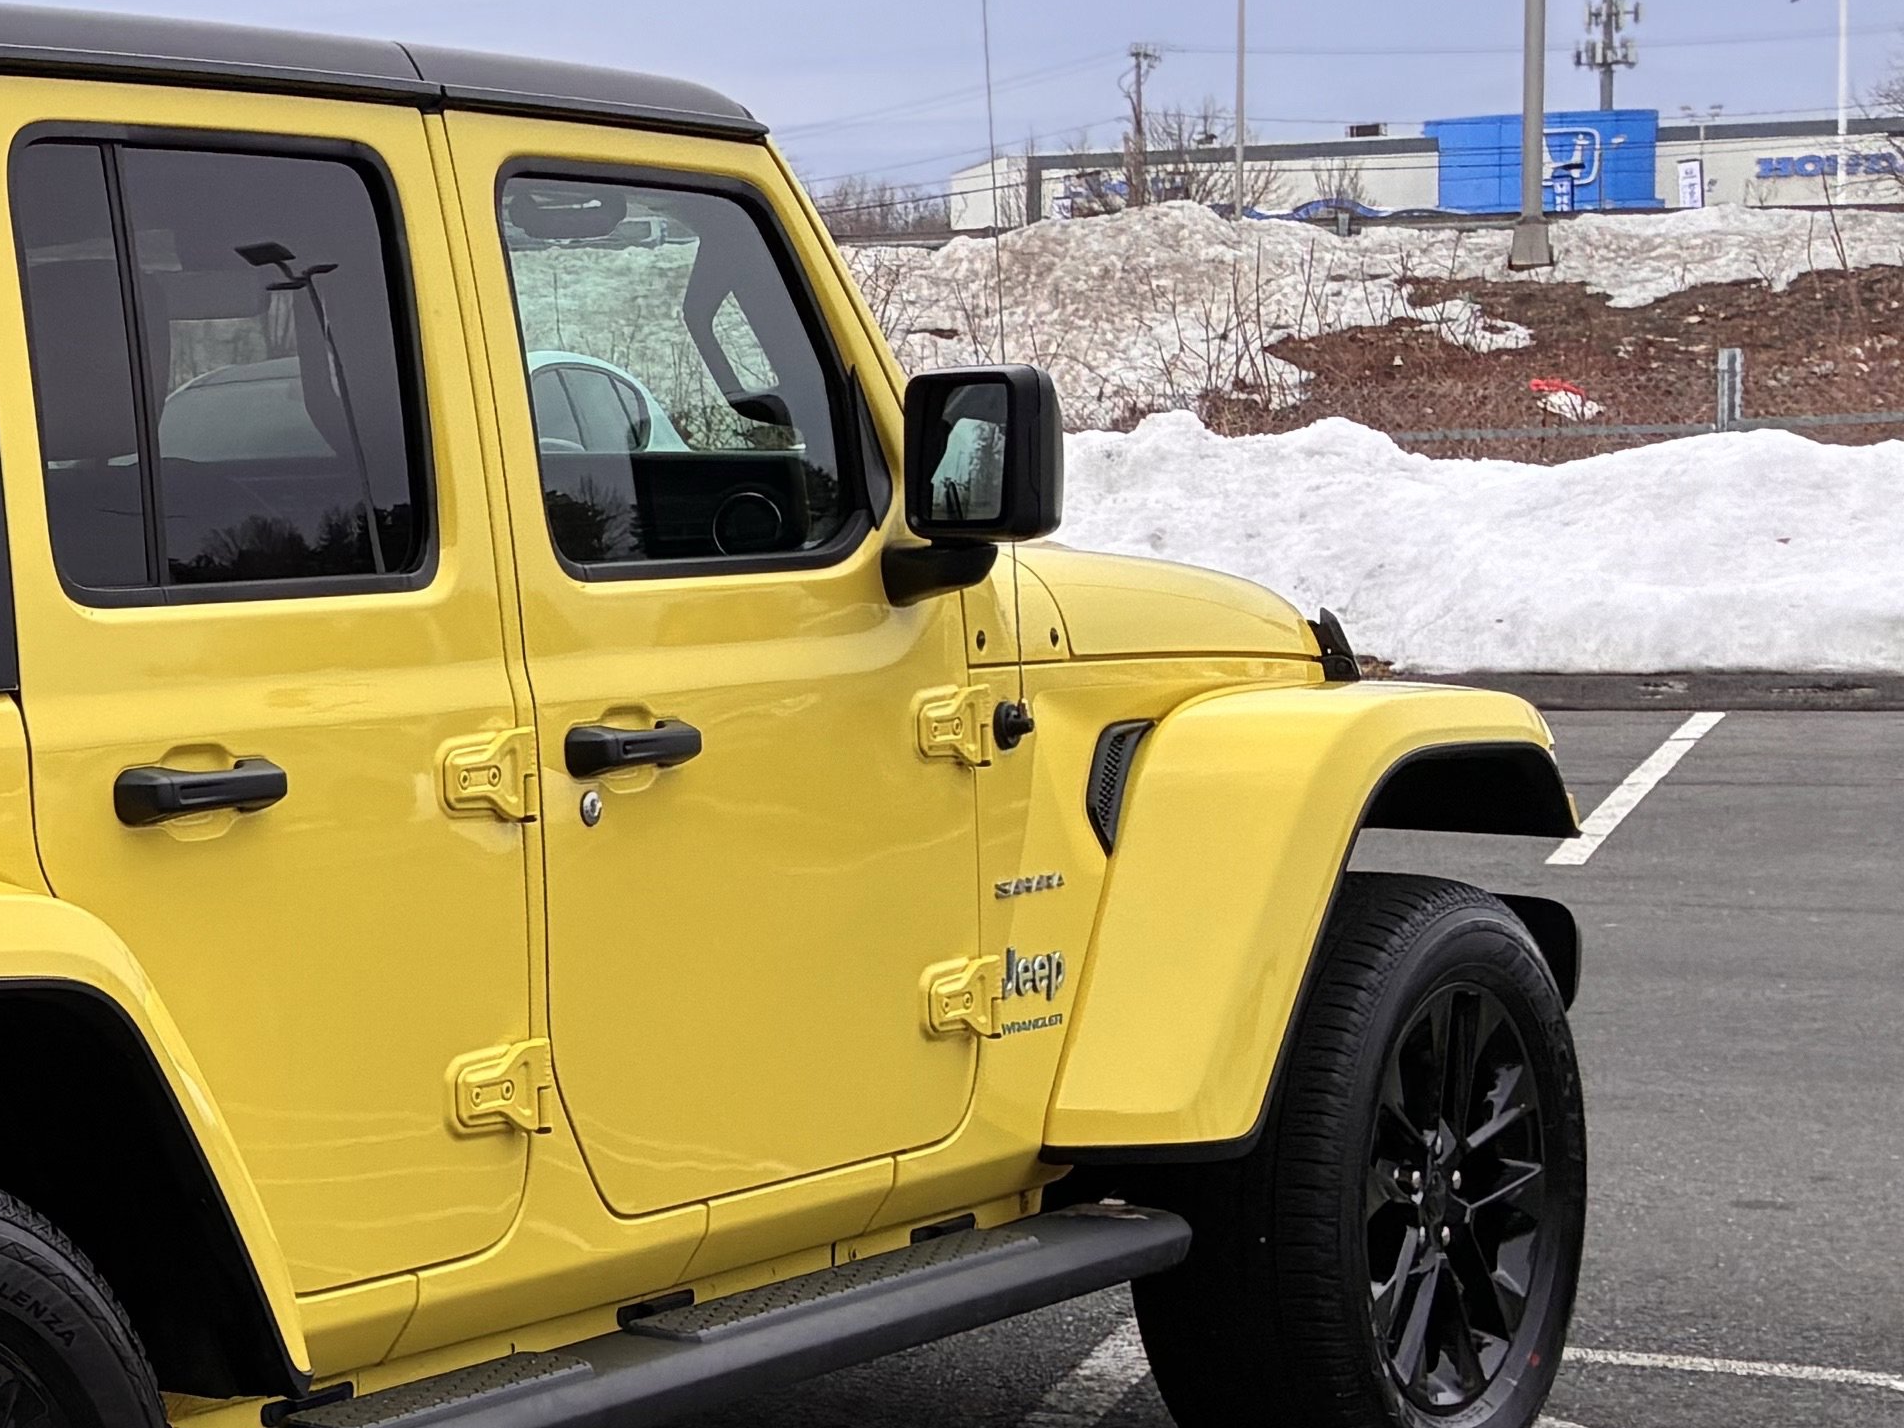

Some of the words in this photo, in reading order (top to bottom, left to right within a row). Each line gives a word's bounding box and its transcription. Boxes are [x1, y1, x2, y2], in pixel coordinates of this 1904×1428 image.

[995, 872, 1065, 900] SAHARA
[1002, 947, 1065, 1002] Jeep
[1001, 1013, 1064, 1036] WRANGLER
